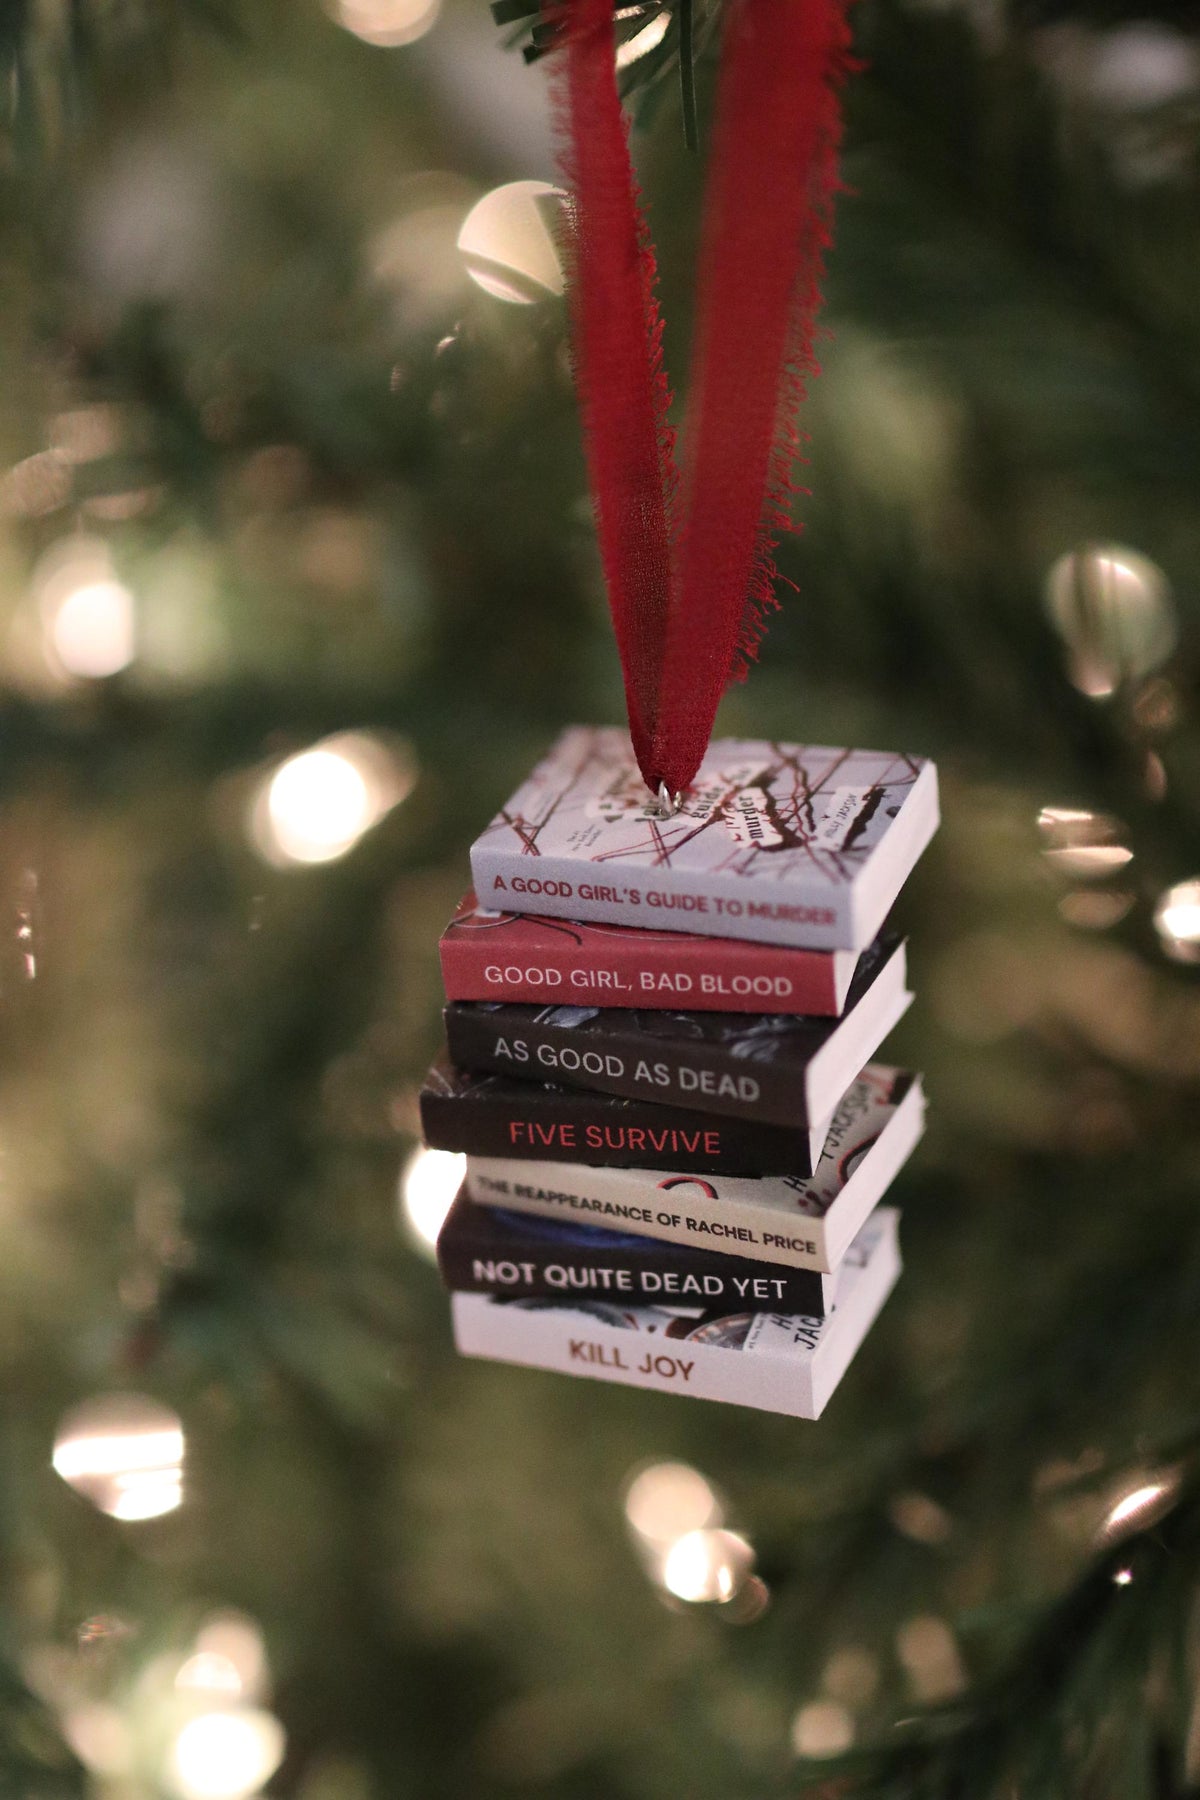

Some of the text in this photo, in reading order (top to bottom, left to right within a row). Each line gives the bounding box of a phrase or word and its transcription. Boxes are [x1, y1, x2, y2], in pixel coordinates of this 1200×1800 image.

[737, 796, 764, 839] murder
[493, 874, 837, 926] A GOOD GIRL'S GUIDE TO MURDER
[484, 965, 793, 997] GOOD GIRL, BAD BLOOD
[494, 1037, 760, 1102] AS GOOD AS DEAD
[509, 1122, 721, 1155] FIVE SURVIVE
[476, 1175, 817, 1255] THE REAPPEARANCE OF RACHEL PRICE
[472, 1258, 788, 1300] NOT QUITE DEAD YET
[568, 1338, 696, 1382] KILL JOY
